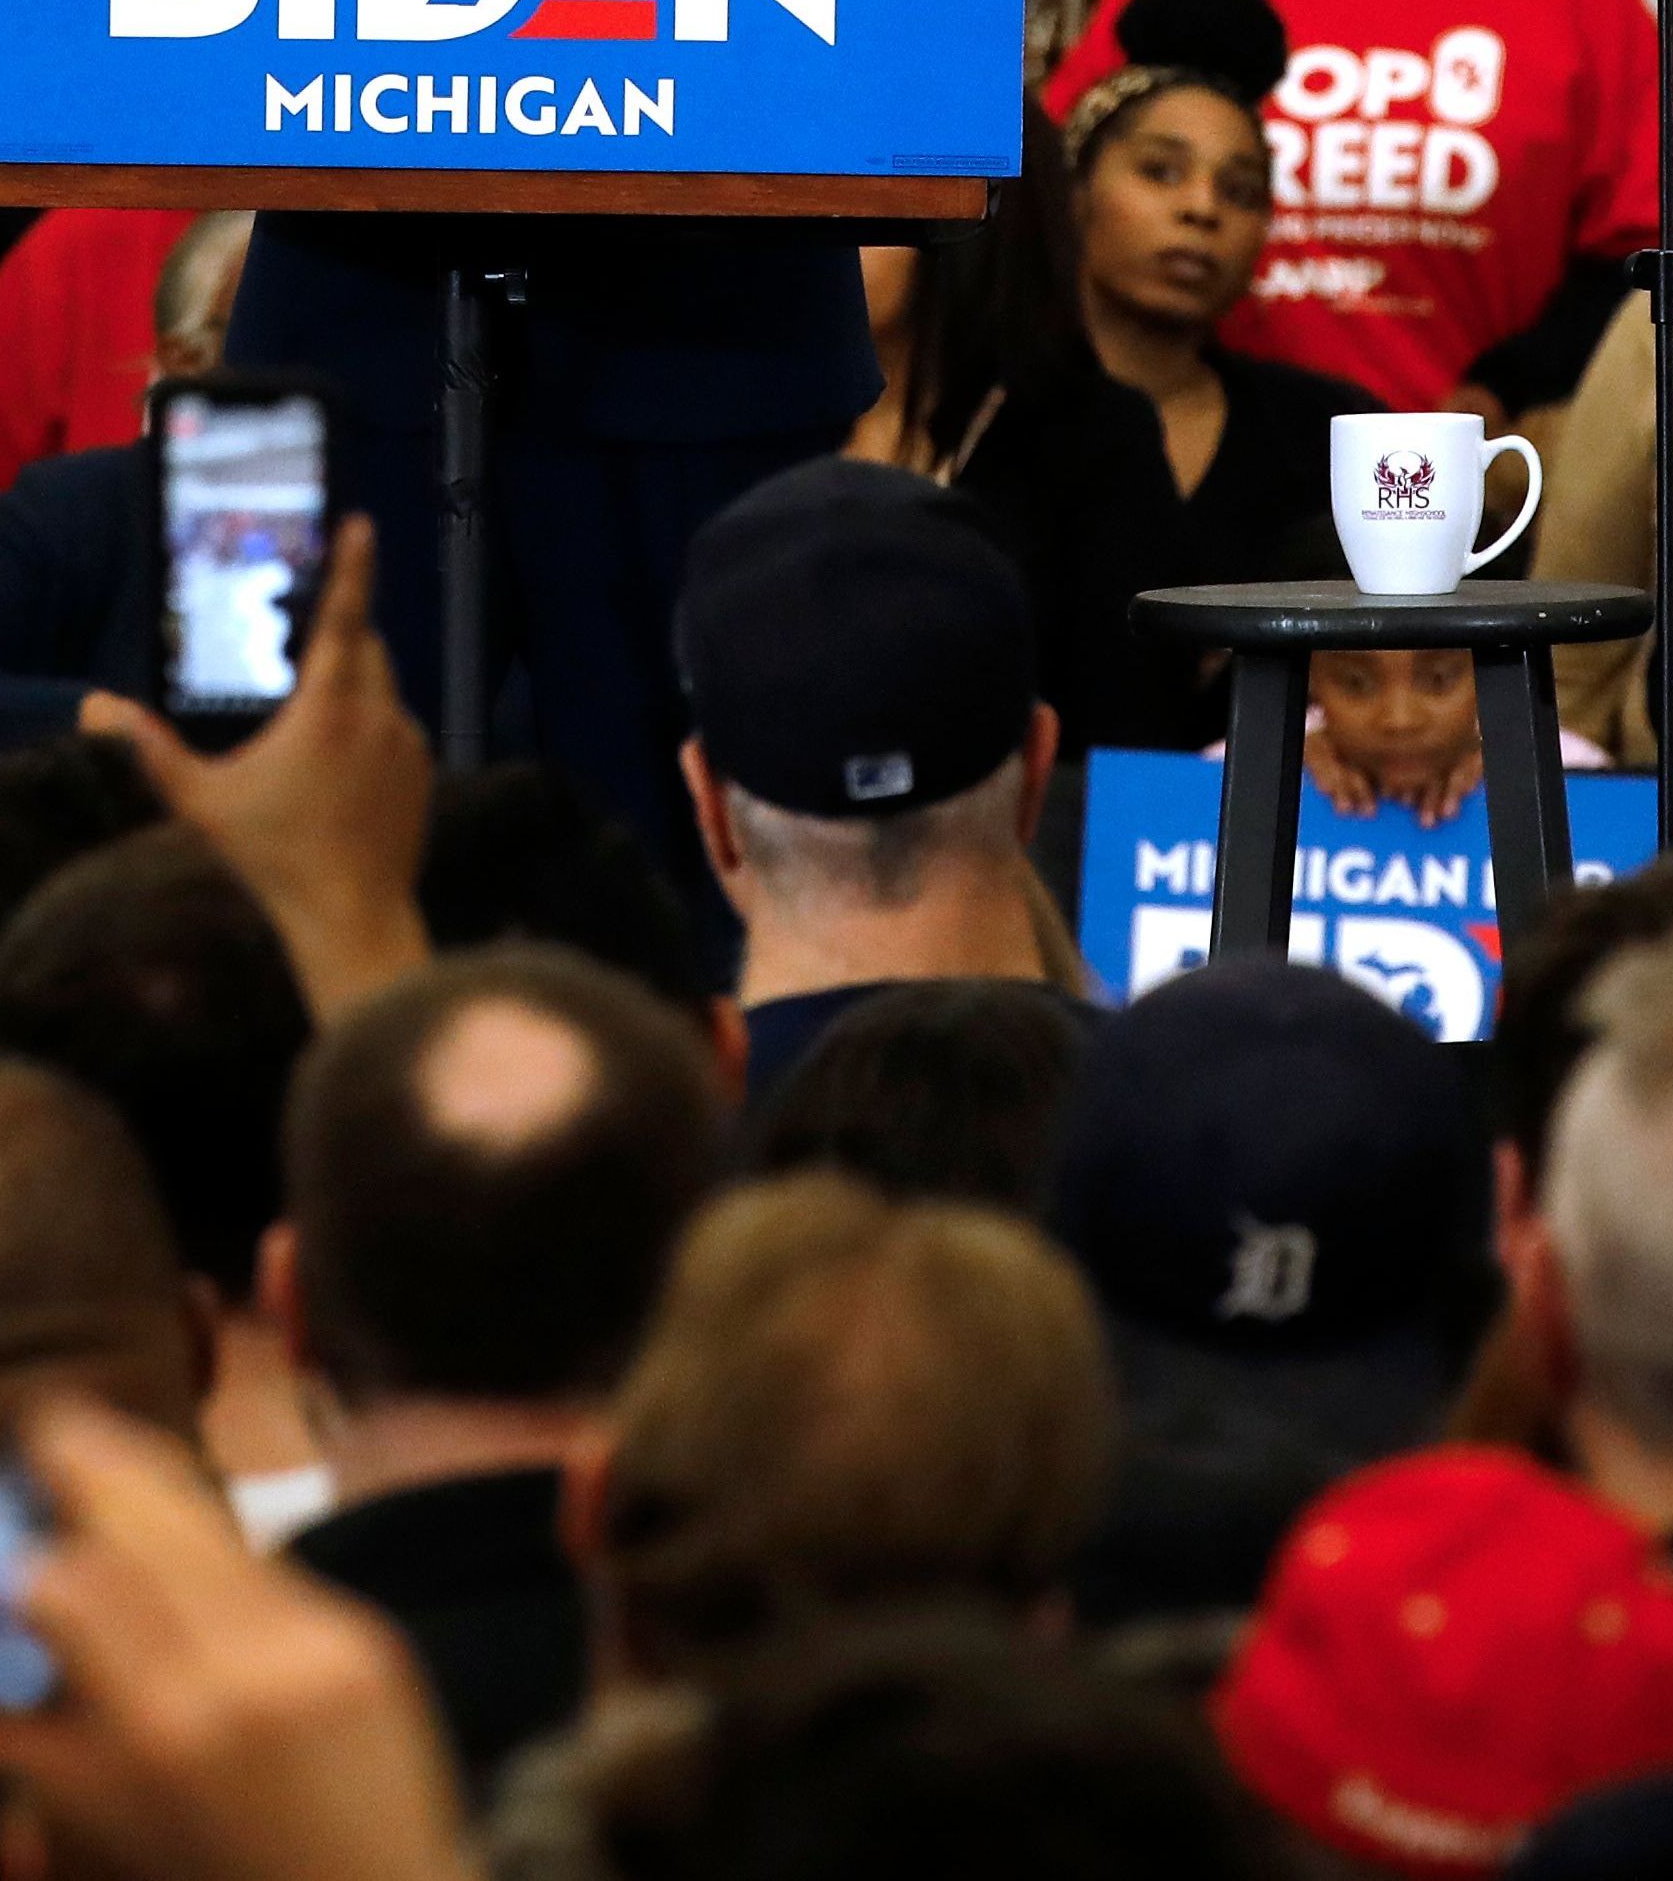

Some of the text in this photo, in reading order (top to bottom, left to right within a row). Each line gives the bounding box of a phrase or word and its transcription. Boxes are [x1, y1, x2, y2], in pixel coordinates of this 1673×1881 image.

[265, 72, 675, 136] MICHIGAN
[1272, 44, 1432, 121] OP
[1263, 118, 1499, 214] REED
[1378, 486, 1430, 509] RHS
[1135, 841, 1469, 907] MIIGAN
